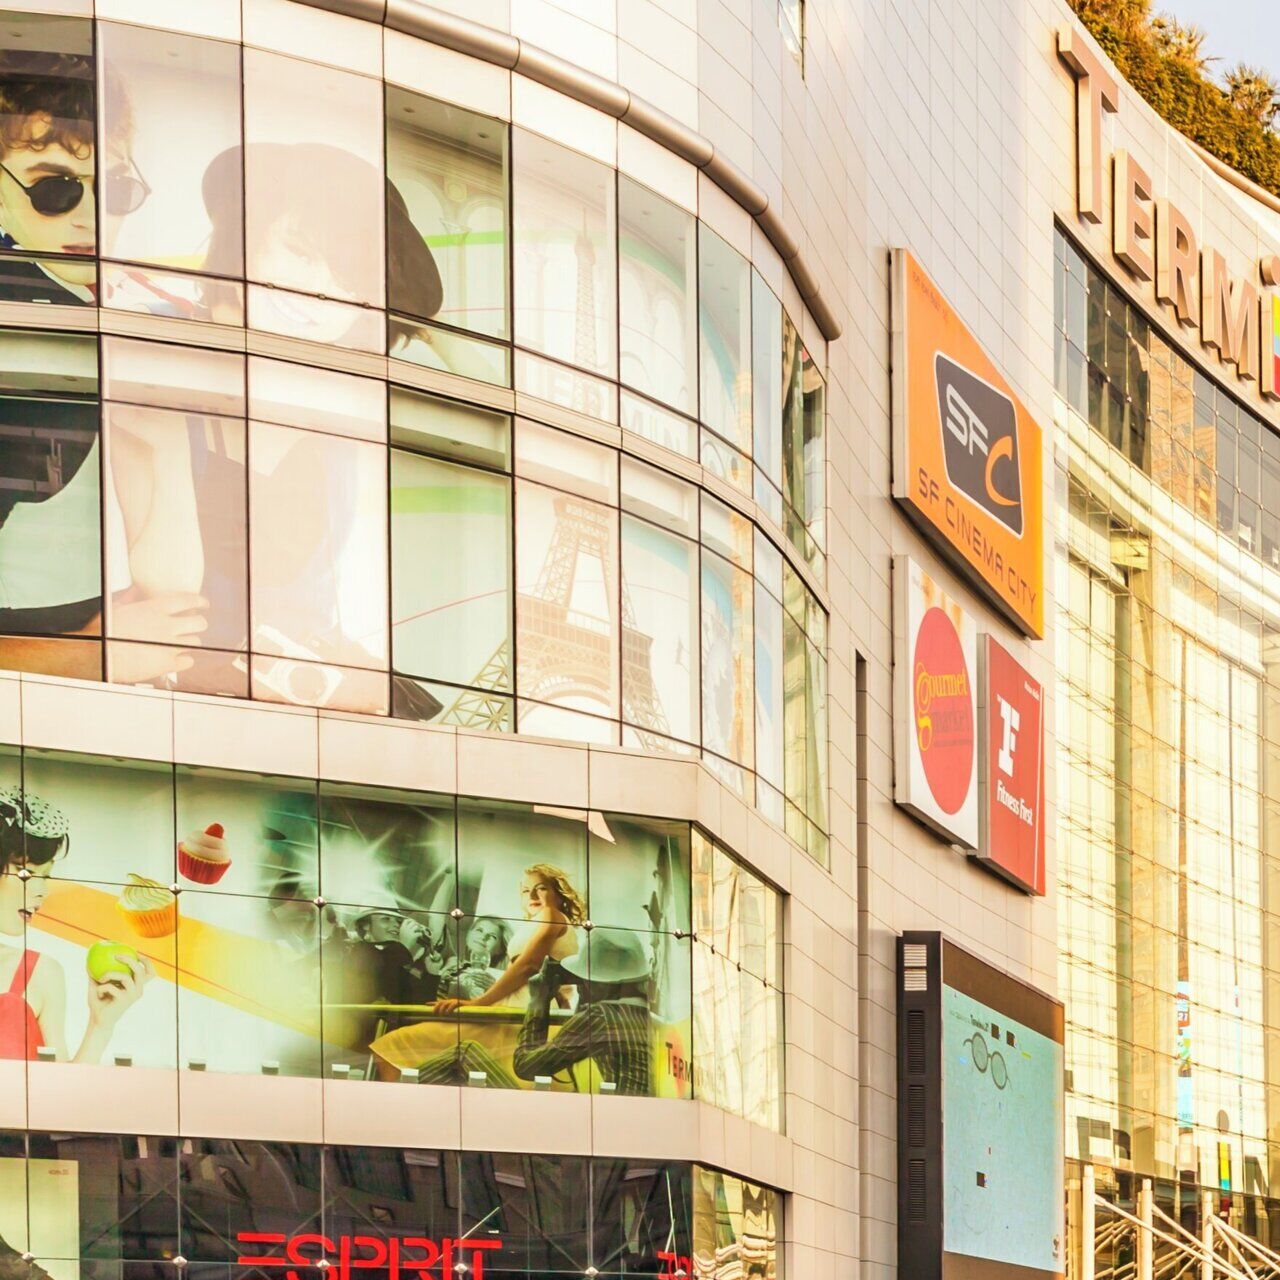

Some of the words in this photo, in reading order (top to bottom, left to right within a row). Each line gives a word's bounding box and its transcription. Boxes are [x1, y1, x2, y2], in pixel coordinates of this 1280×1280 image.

[945, 383, 1021, 507] SFC
[917, 466, 940, 513] SF
[944, 495, 1005, 584] CINEMA
[1007, 566, 1038, 615] CITY
[996, 779, 1020, 816] Fitness
[1019, 799, 1034, 828] First
